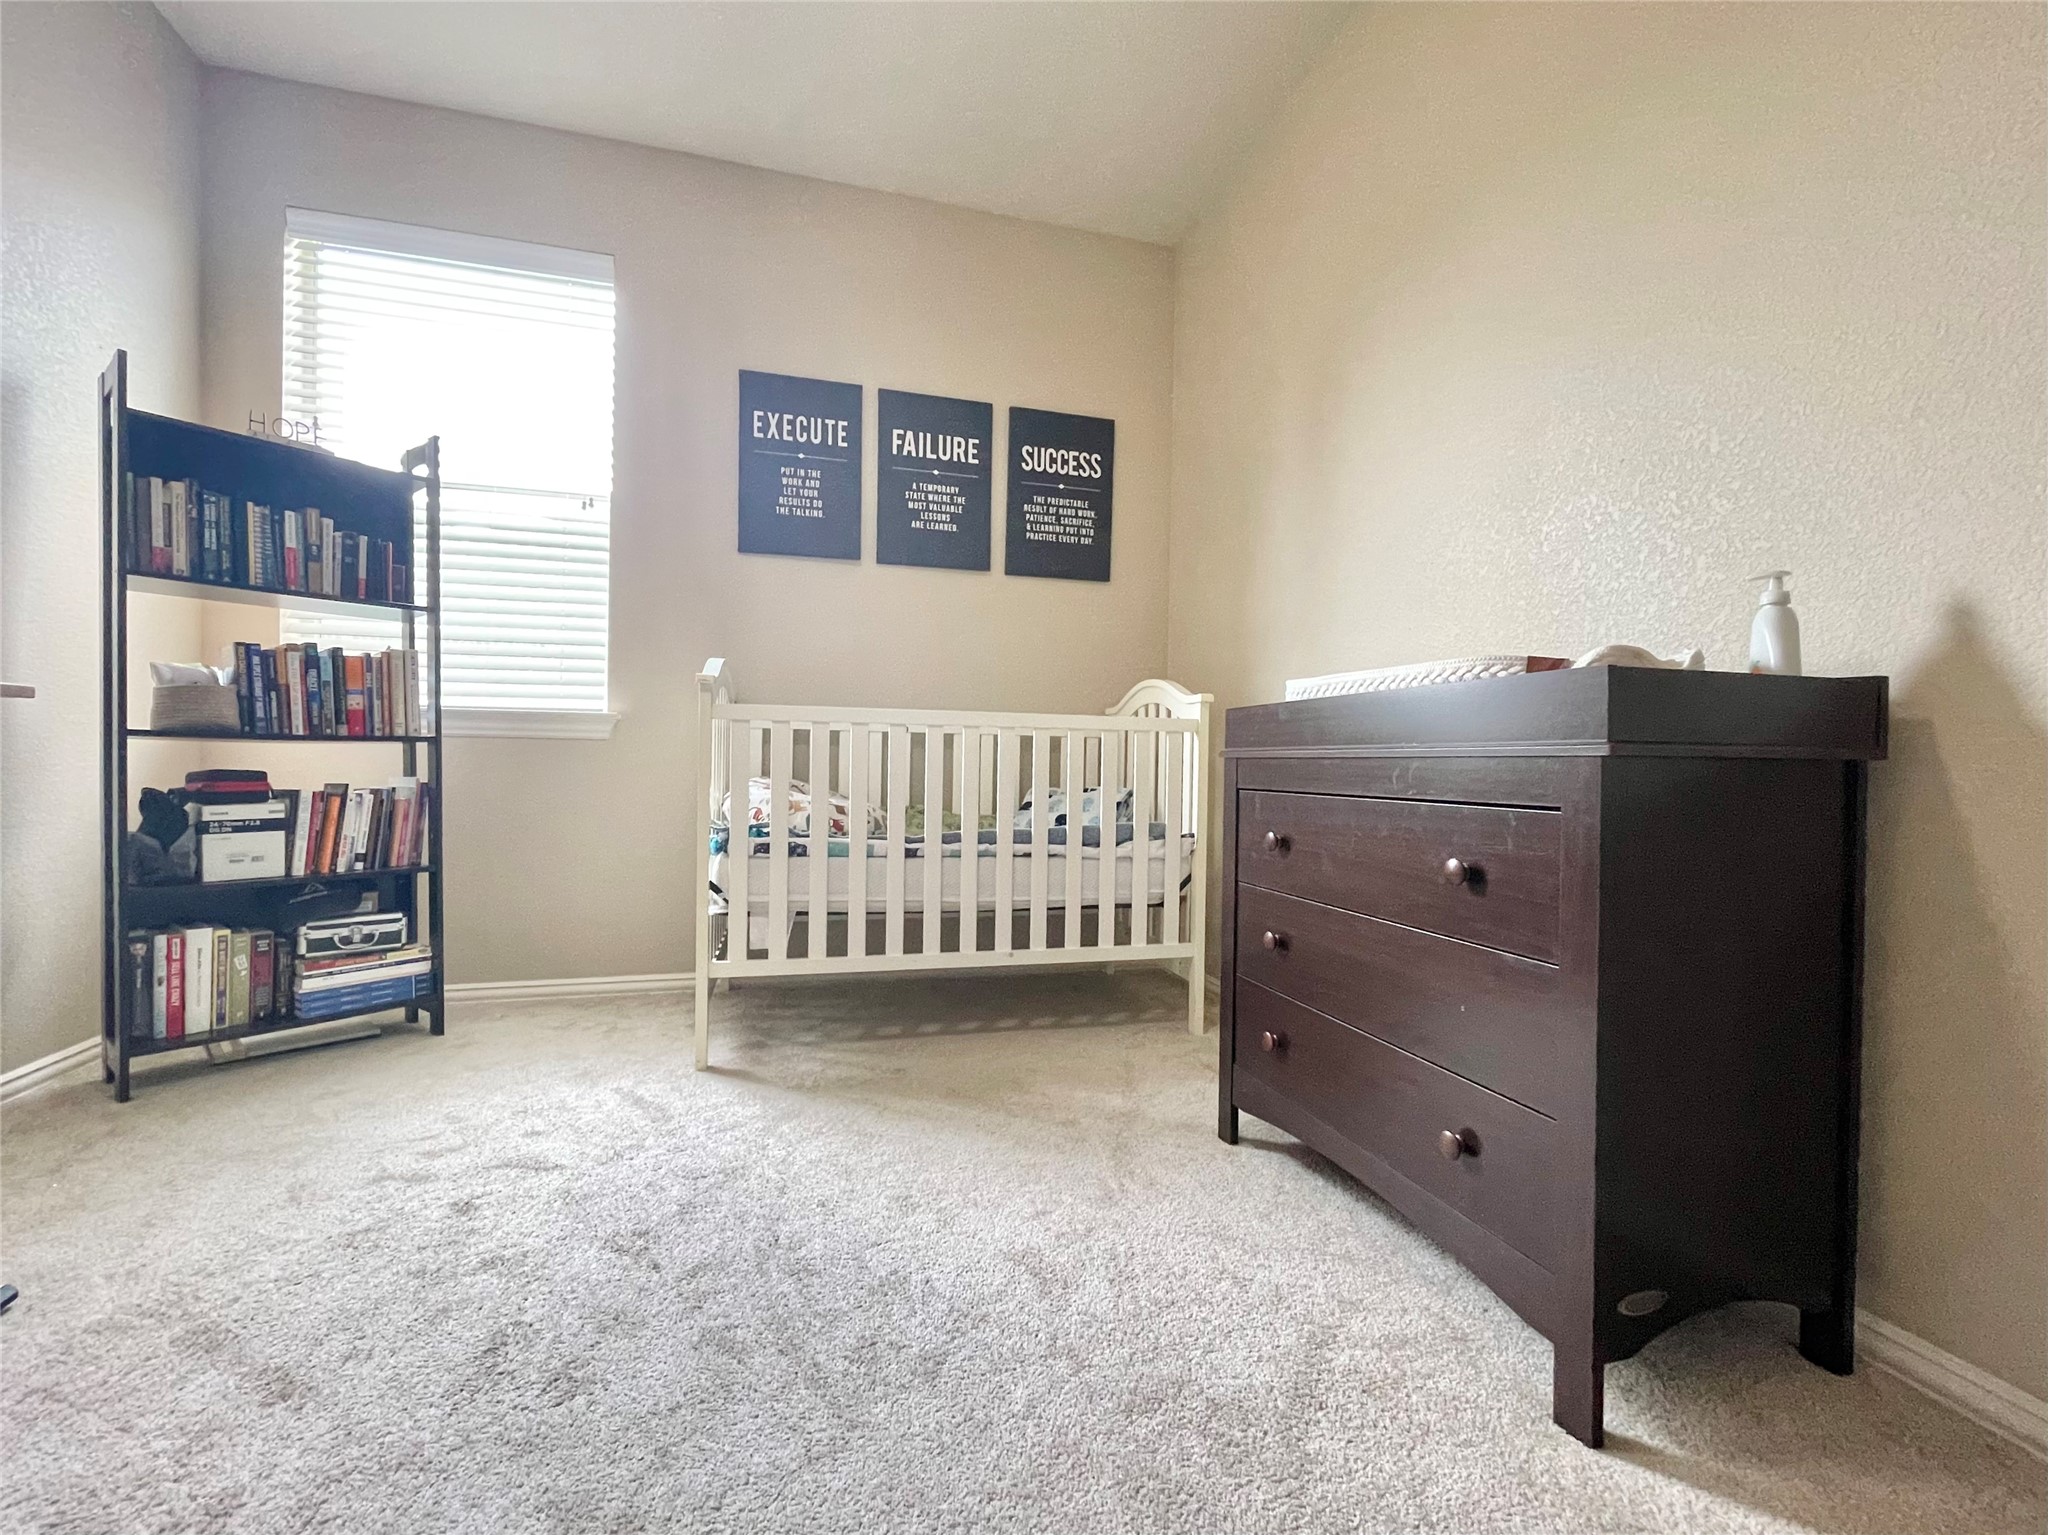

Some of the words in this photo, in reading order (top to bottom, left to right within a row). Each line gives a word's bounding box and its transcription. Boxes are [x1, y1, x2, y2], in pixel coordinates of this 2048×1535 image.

[249, 410, 327, 446] HOPE
[753, 411, 848, 447] EXECUTE
[892, 428, 980, 464] FAILURE
[1021, 445, 1102, 479] SUCCESS
[781, 466, 794, 476] PUT
[797, 468, 805, 477] IN
[808, 469, 821, 479] THE
[781, 476, 803, 487] WORK
[805, 479, 820, 488] AND
[912, 482, 917, 490] A
[919, 482, 959, 494] TEMPORARY
[783, 486, 796, 496] LET
[799, 488, 818, 498] YOUR
[905, 491, 926, 501] STATE
[928, 493, 951, 503] WHERE
[953, 495, 966, 505] THE
[779, 496, 811, 507] RESULTS
[813, 499, 823, 508] DO
[908, 501, 926, 510] MOST
[928, 503, 963, 514] VALUABLE
[1033, 496, 1045, 504] THE
[1047, 497, 1089, 509] PREDICTABLE
[776, 506, 789, 515] THE
[792, 507, 826, 519] TALKING.
[921, 511, 951, 522] LESSONS
[1023, 504, 1047, 513] RESULT
[1049, 506, 1057, 514] OF
[1058, 507, 1076, 516] HARD
[911, 520, 924, 529] ARE
[926, 522, 960, 533] LEARNED.
[1033, 523, 1064, 533] LEARNING
[1066, 526, 1078, 534] PUT
[1080, 528, 1095, 536] INTO
[1026, 532, 1057, 541] PRACTICE
[1058, 535, 1079, 543] EVERY
[1080, 537, 1095, 545] DAY.
[171, 988, 180, 1006] CRAZY
